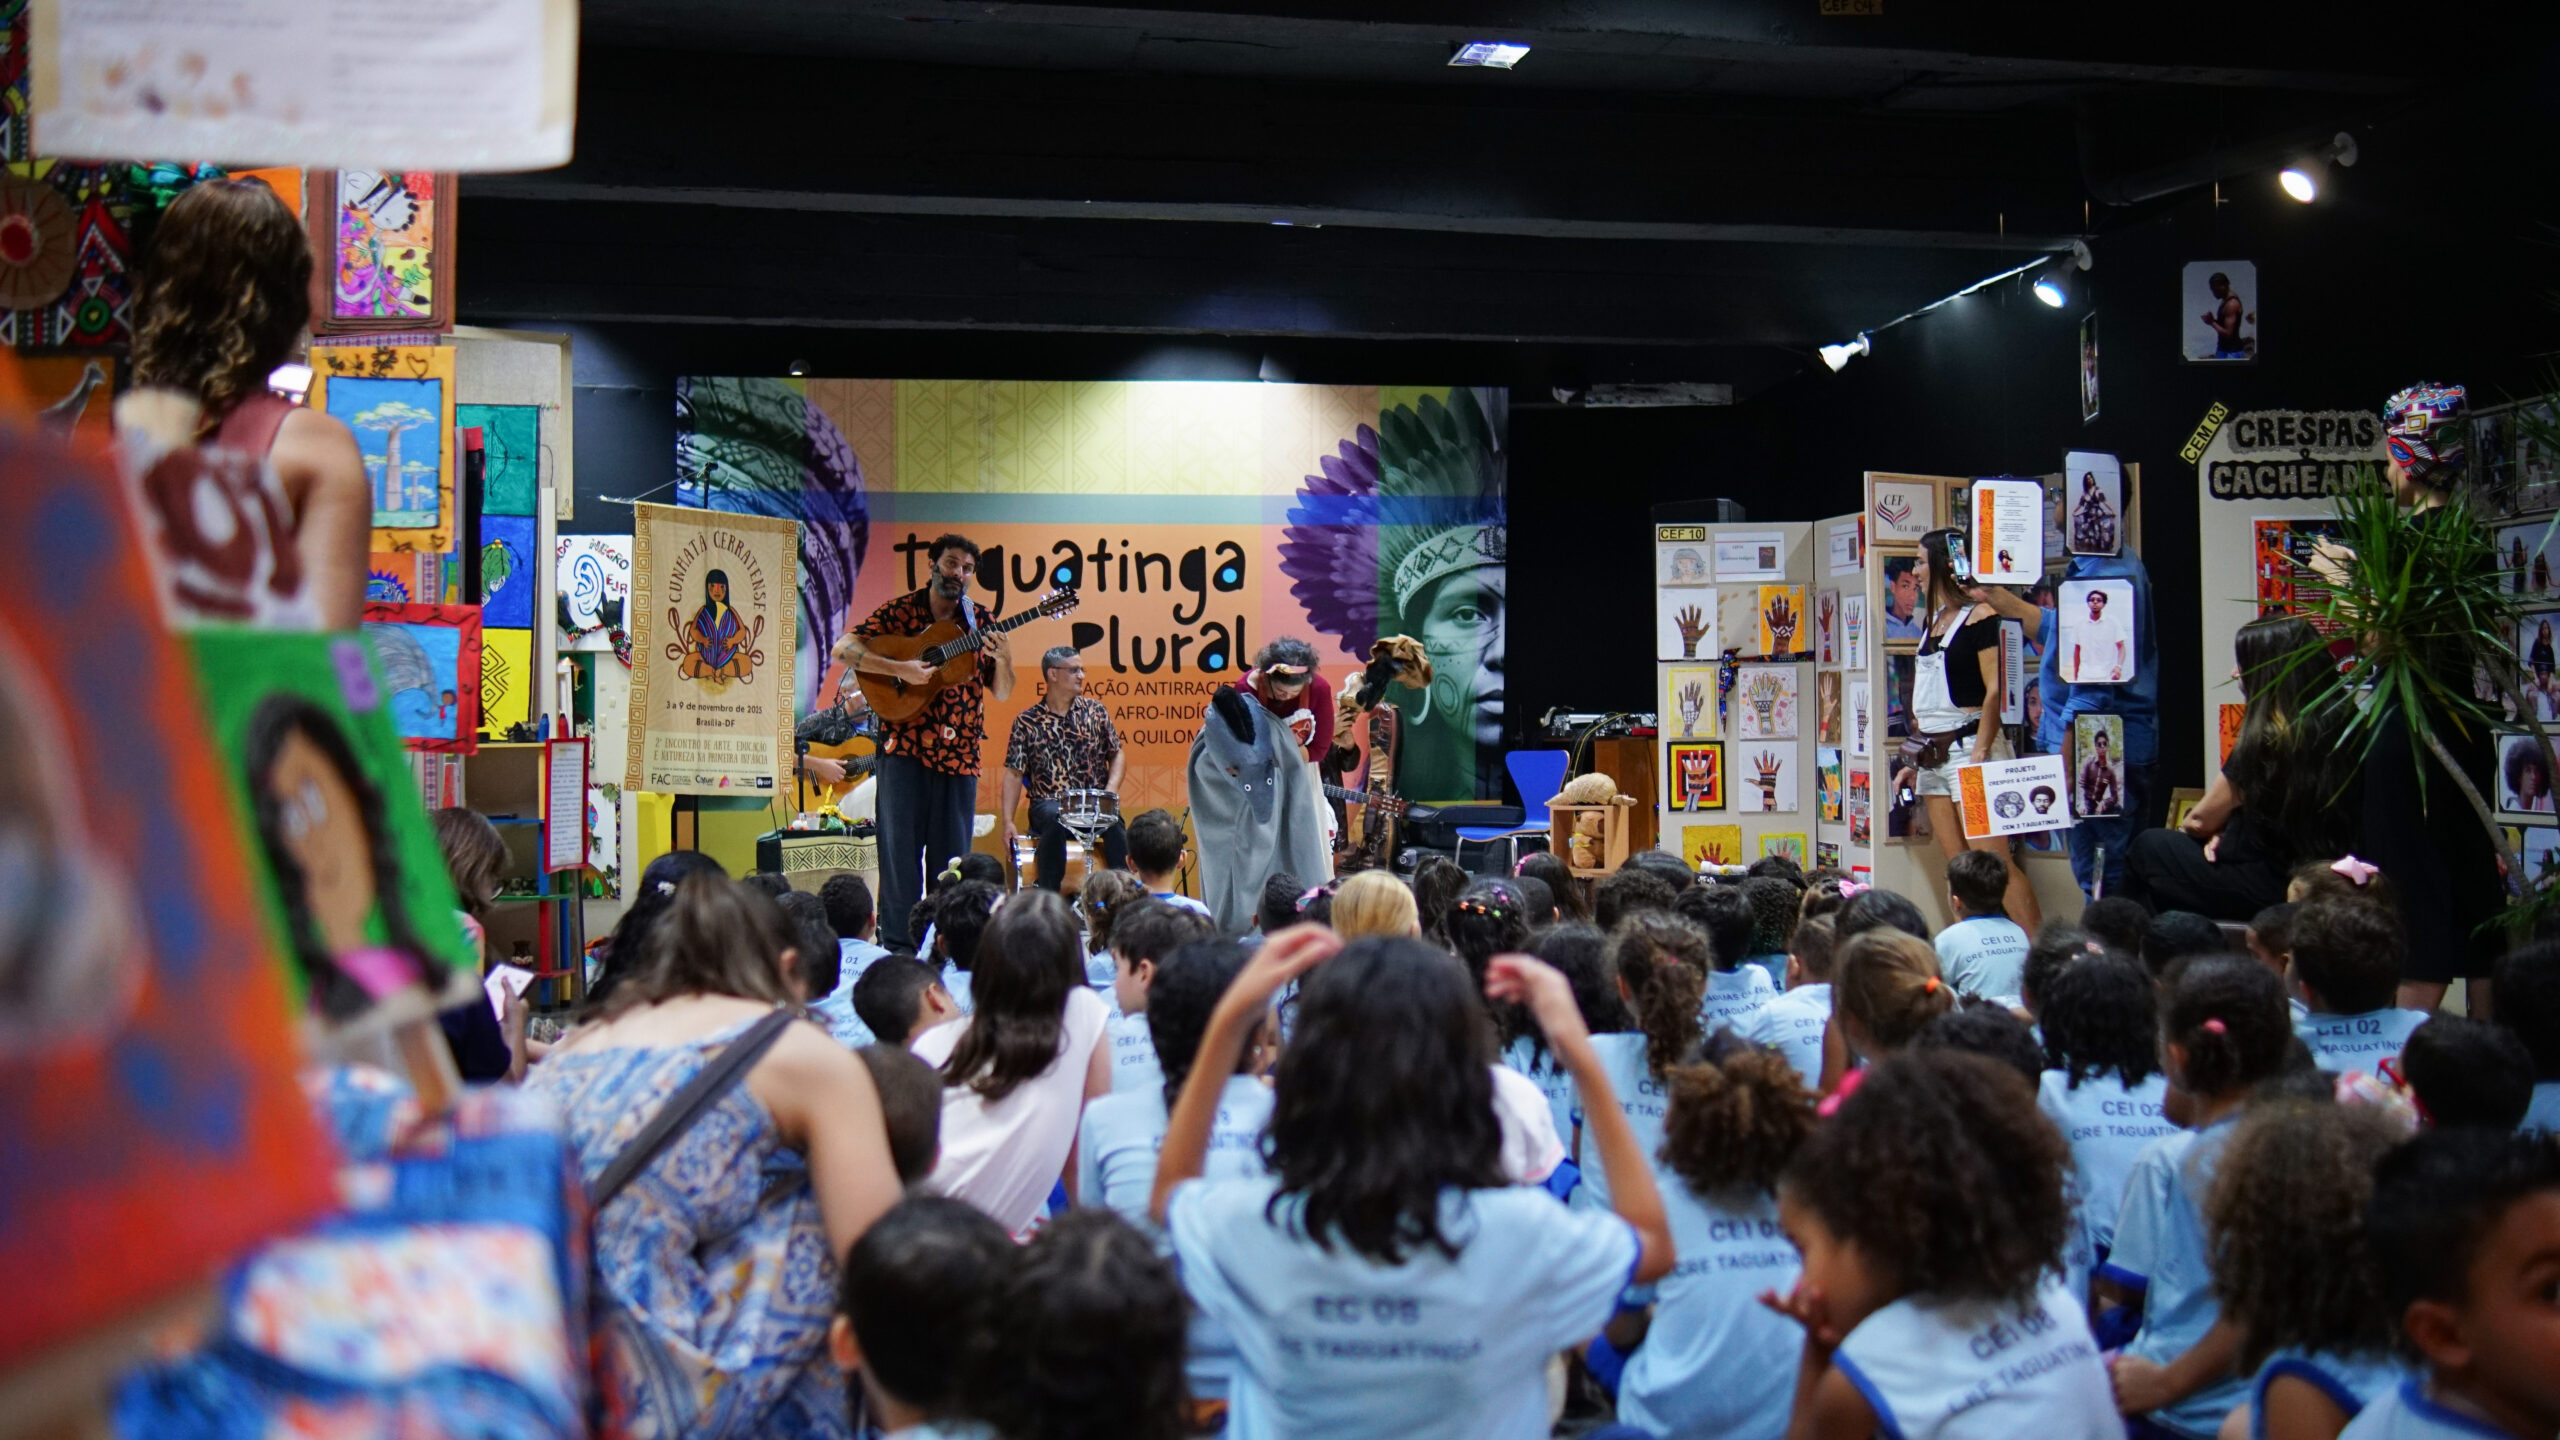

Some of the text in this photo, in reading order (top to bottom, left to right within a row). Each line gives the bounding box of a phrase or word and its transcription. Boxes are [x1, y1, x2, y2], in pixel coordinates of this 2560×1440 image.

[2184, 405, 2226, 461] CEM 03
[2235, 417, 2375, 447] CRESPAS
[1883, 494, 1905, 506] CEF
[1660, 529, 1702, 539] CEF 10
[589, 538, 630, 570] NEGRO
[668, 530, 767, 612] CUNHATÃ CERRATENSE
[893, 533, 1246, 625] tguatinga
[1036, 678, 1129, 699] EAÇÃO
[666, 700, 671, 709] 3
[679, 701, 684, 710] 9
[686, 702, 696, 710] de
[698, 703, 733, 713] novembro
[736, 705, 745, 713] de
[665, 738, 700, 749] ENCONTRO
[2005, 765, 2036, 774] PROJETO
[651, 773, 671, 786] FAC
[1981, 935, 2017, 946] CEI 01
[845, 956, 859, 965] 01
[1966, 952, 1984, 963] CRE
[2356, 1019, 2382, 1035] 02
[2102, 1101, 2165, 1117] CEI 02
[2072, 1126, 2102, 1140] CRE
